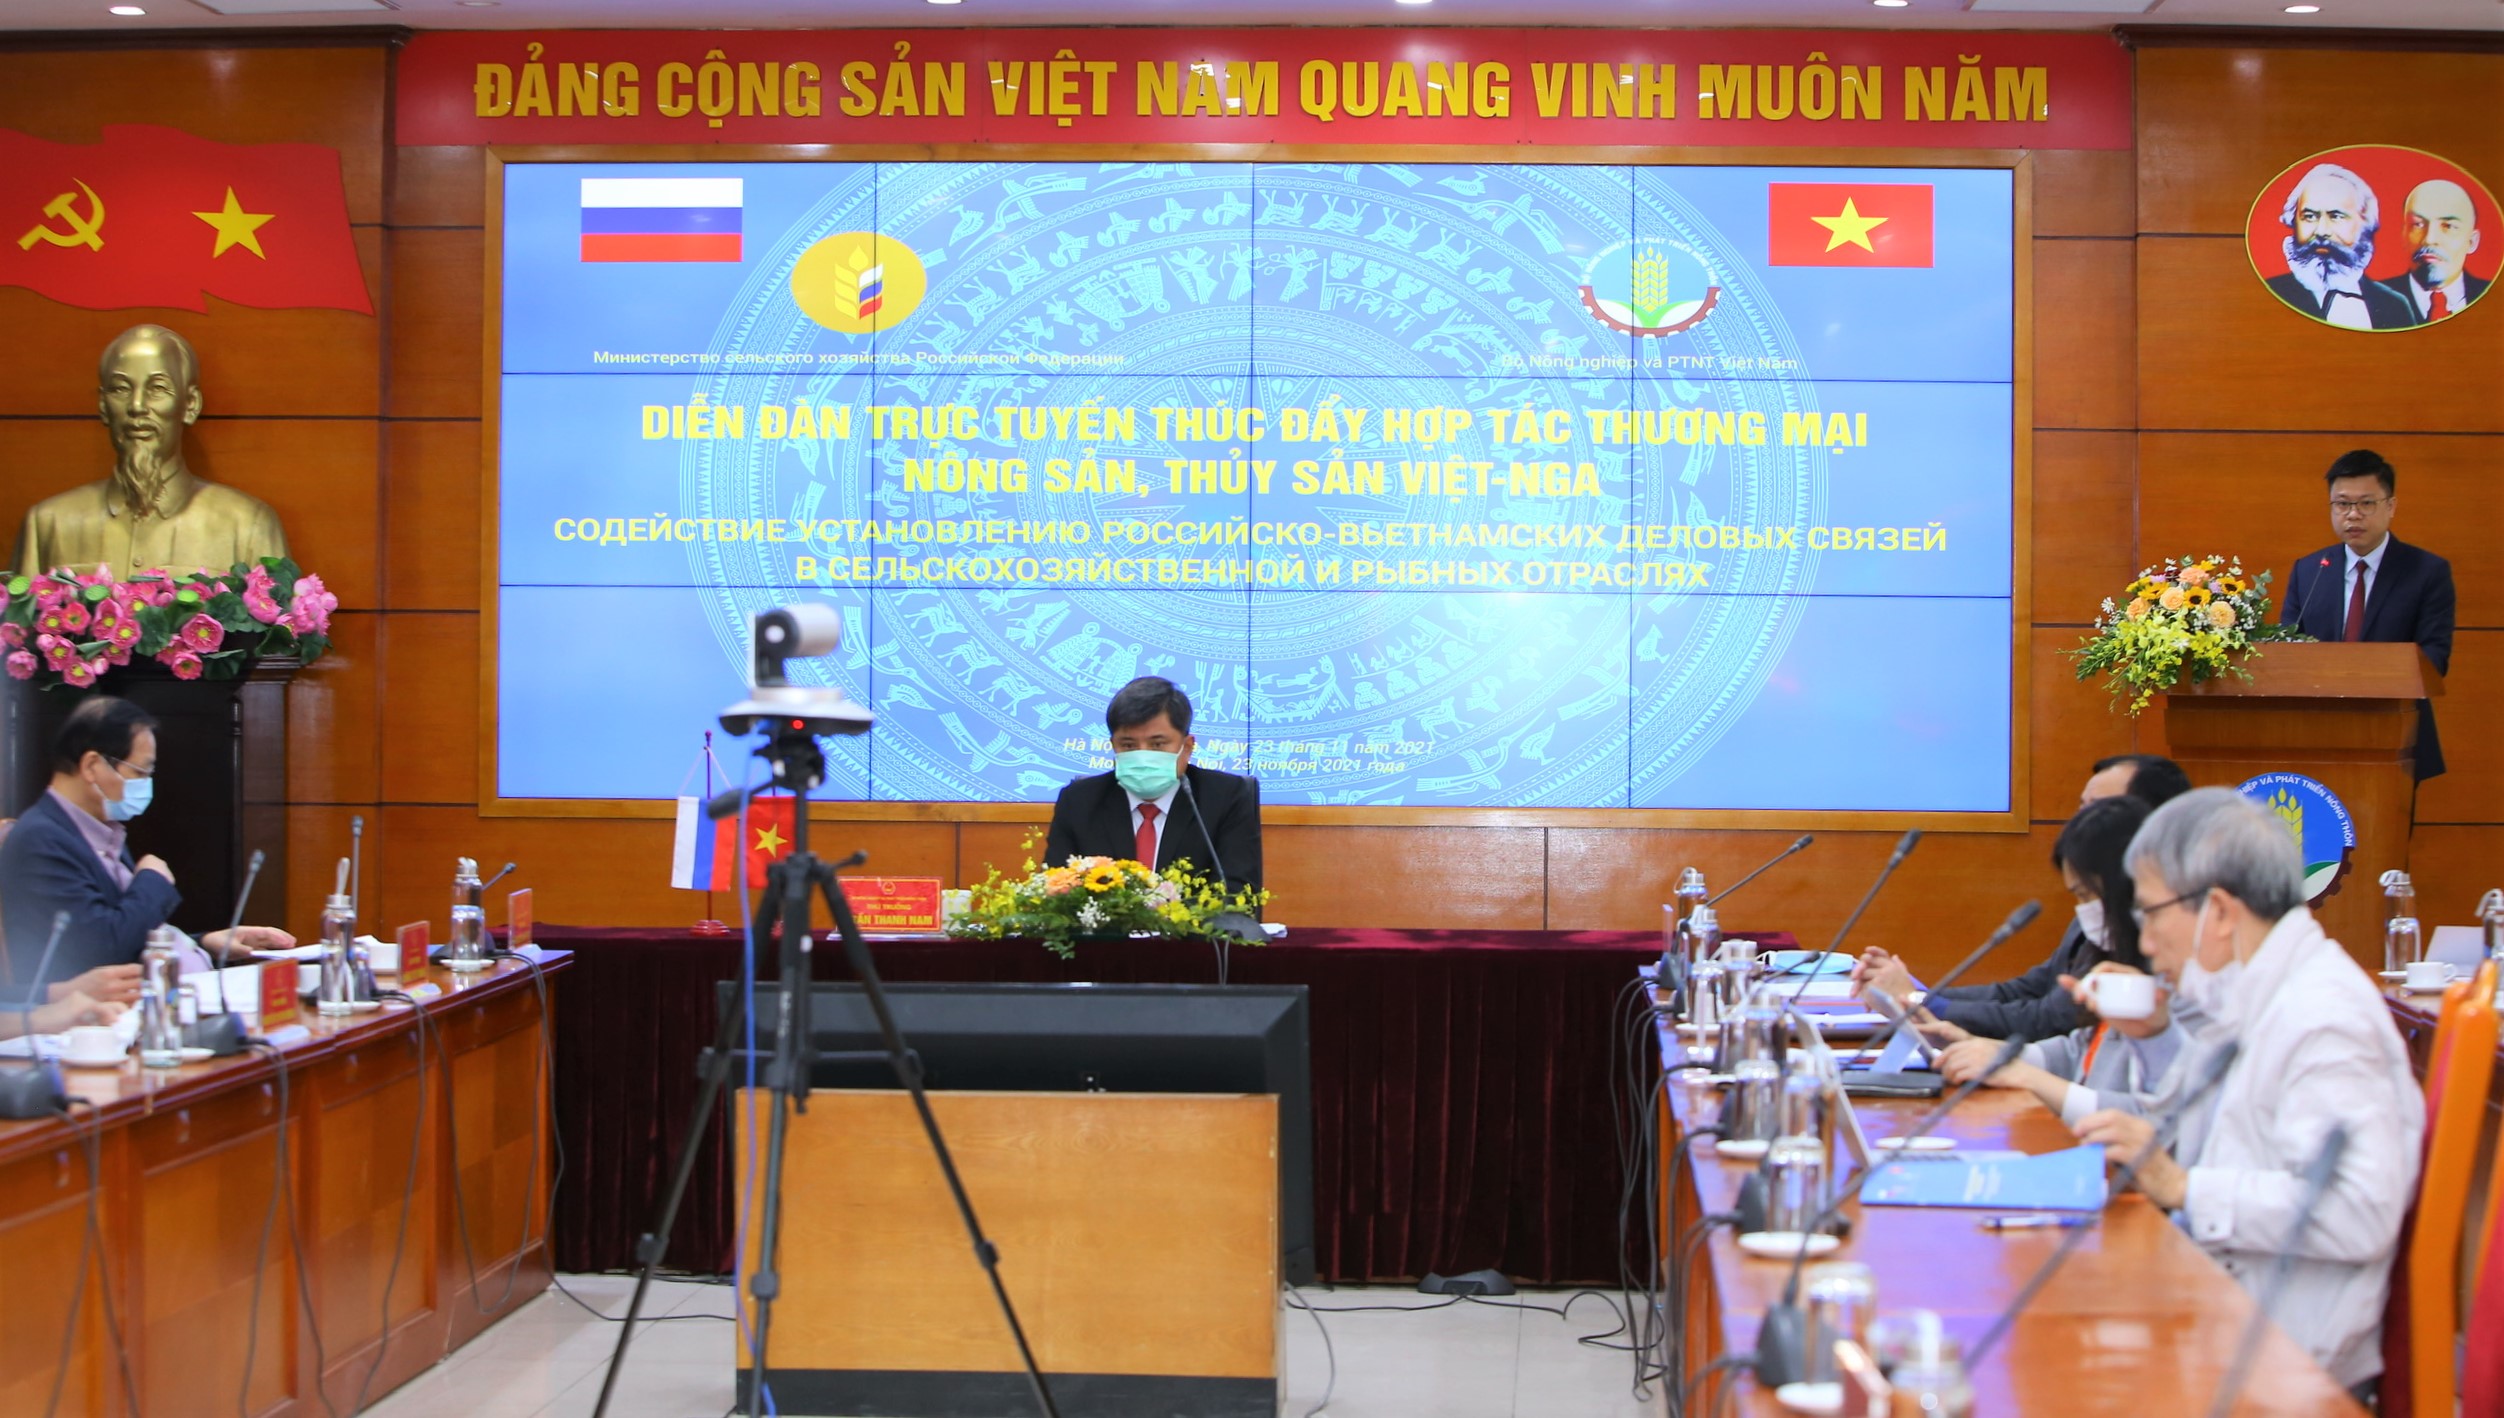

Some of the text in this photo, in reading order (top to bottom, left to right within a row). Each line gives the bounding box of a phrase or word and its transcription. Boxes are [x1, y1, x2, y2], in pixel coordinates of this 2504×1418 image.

[474, 40, 2048, 127] ĐẢNG CỘNG SẢN VIỆT NAM QUANG VINH MUÔN NĂM
[594, 351, 1124, 367] Министерство сельского хозяйства Российской Федерации
[1668, 356, 1714, 369] PTNT
[1758, 357, 1798, 370] Nam
[642, 393, 1868, 454] DIỄN ĐÀN TRỰC TUYẾN THÚC ĐẨY HỢP TÁC THƯƠNG MẠI
[903, 447, 1602, 504] NÔNG SẢN, THỦY SẢN VIỆT-NGA
[554, 512, 1947, 552] СОДЕЙСТВИЕ УСТАНОВЛЕНИЮ РОССИЙСКО-ВЬЕТНАМСКИХ ДЕЛОВЫХ СВЯЗЕЙ
[795, 553, 1709, 588] В СЕЛЬСКОХОЗЯЙСТВЕННОЙ И РЫБНЫХ ОТРАСЛЯХ
[1232, 759, 1252, 771] 23
[1257, 758, 1318, 774] ноября
[1323, 759, 1363, 771] 2021
[1367, 760, 1406, 774] года
[1255, 740, 1274, 754] 23
[1332, 740, 1349, 753] 11
[1394, 741, 1434, 755] 2021
[2275, 775, 2301, 785] PHÁT
[2302, 779, 2327, 798] TRIỂN
[2325, 795, 2346, 820] NÔNG
[2340, 819, 2354, 847] THÔN
